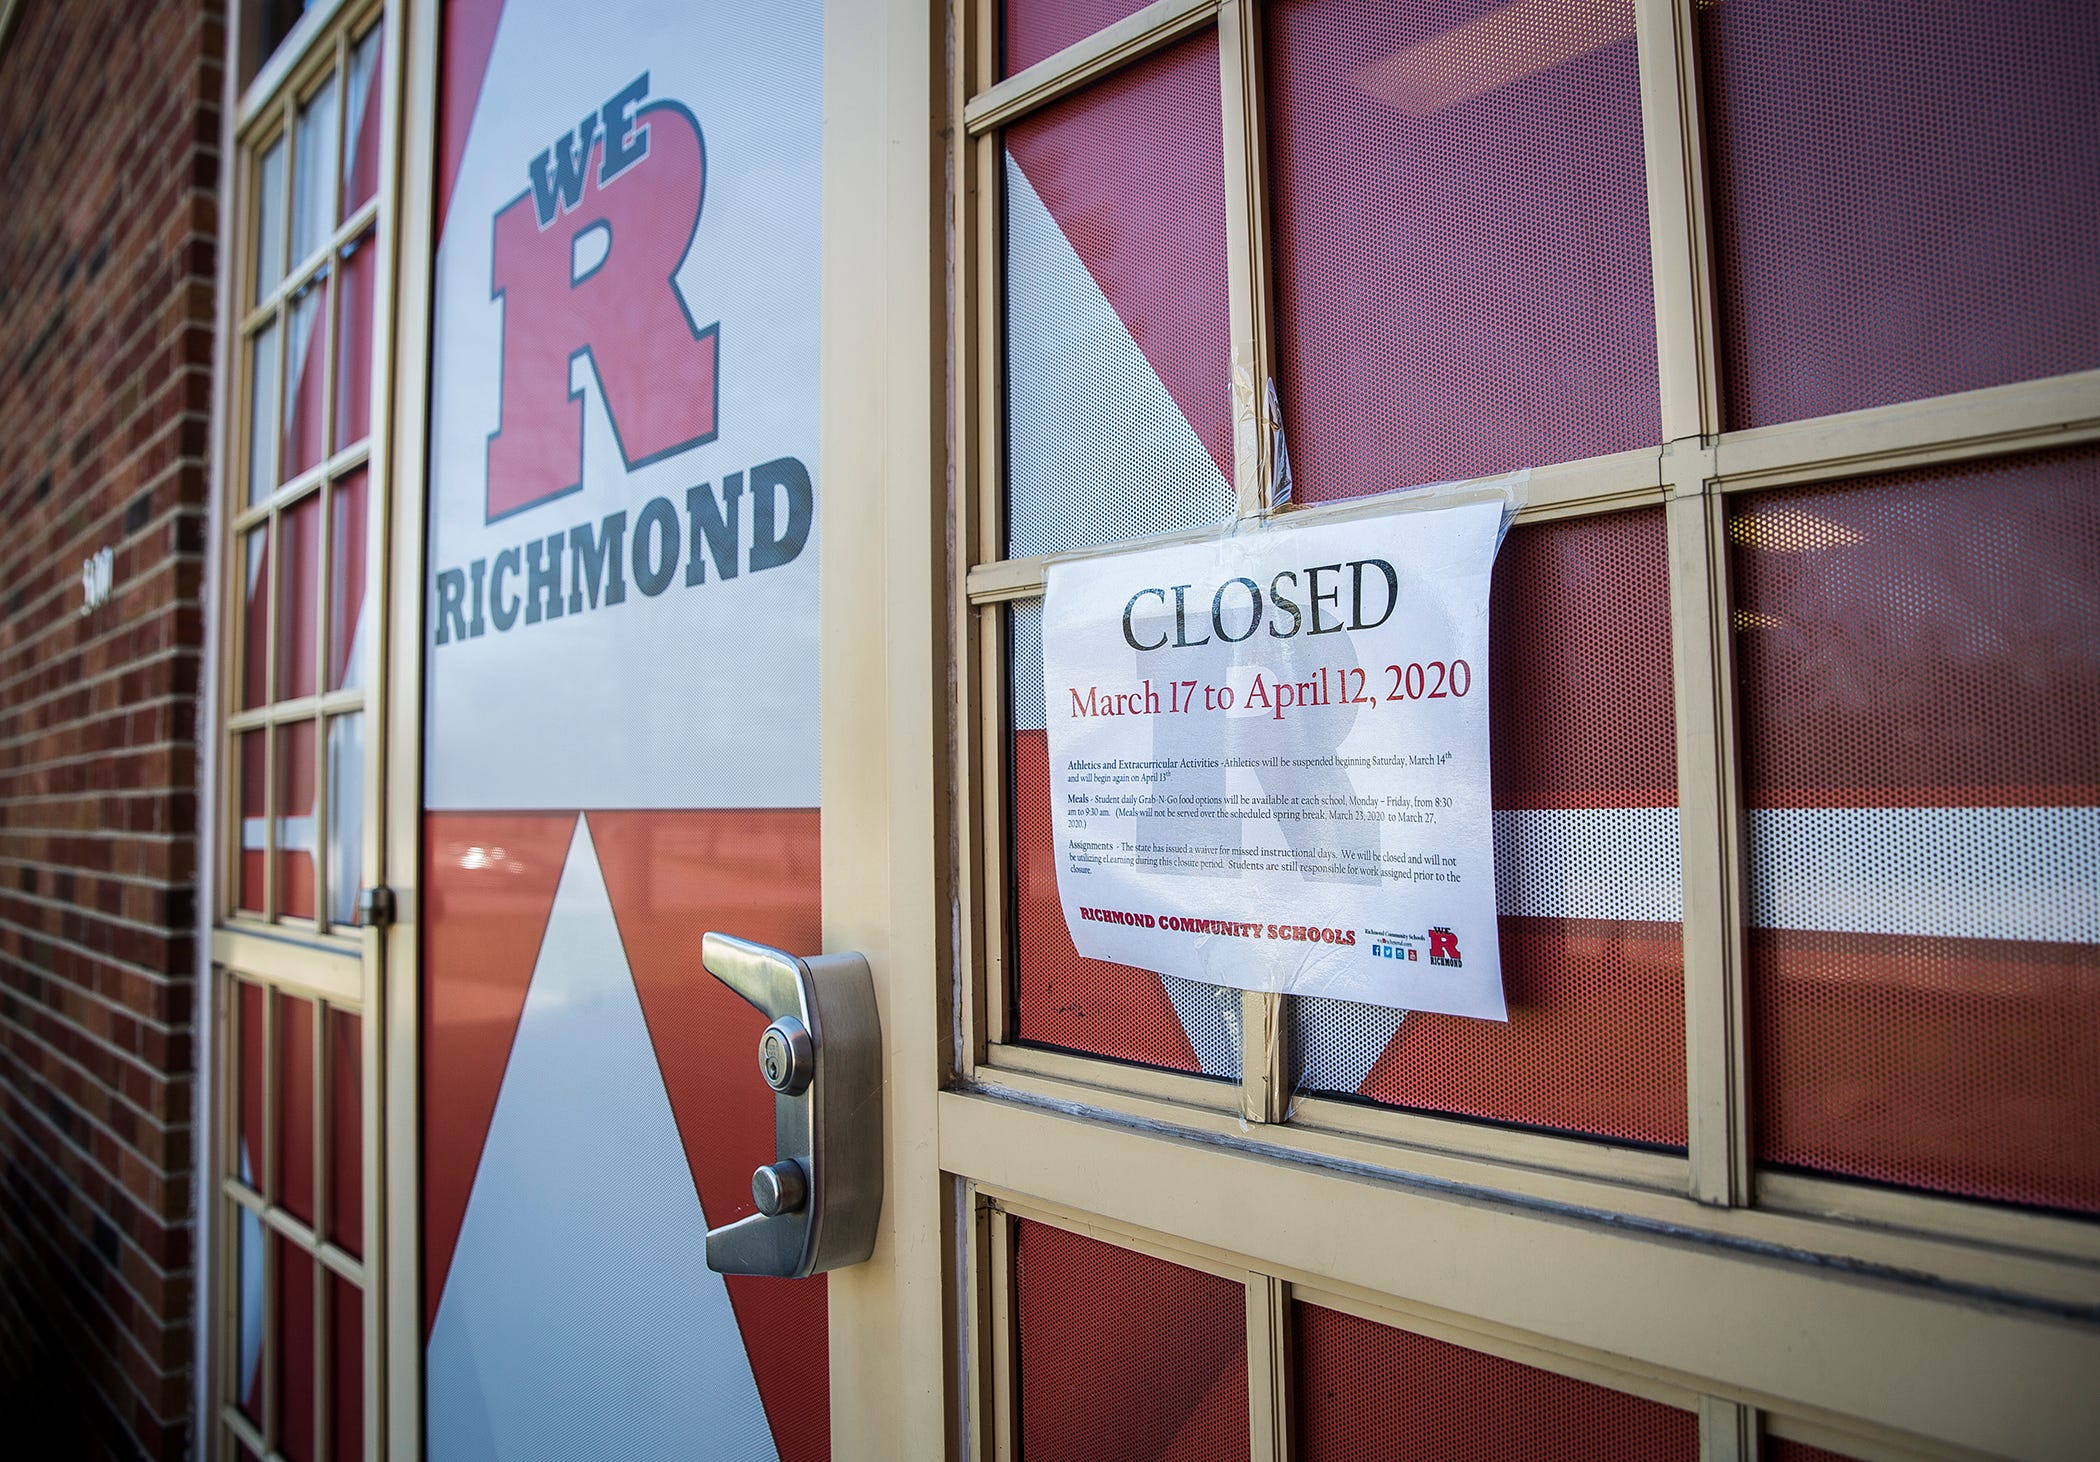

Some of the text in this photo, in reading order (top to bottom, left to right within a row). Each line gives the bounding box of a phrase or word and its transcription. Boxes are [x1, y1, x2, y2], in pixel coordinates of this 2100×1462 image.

[528, 69, 651, 232] WE
[485, 97, 721, 527] R
[434, 456, 814, 648] RICHMOND
[1122, 558, 1399, 652] CLOSED
[1069, 658, 1471, 720] March 17 to April 12, 2020
[1067, 759, 1101, 770] Athletics
[1102, 759, 1117, 770] and
[1119, 757, 1178, 770] Extracurricular
[1180, 757, 1219, 768] Activities
[1262, 756, 1278, 767] will
[1280, 756, 1291, 767] be
[1292, 755, 1334, 769] suspended
[1335, 755, 1371, 769] beginning
[1372, 754, 1408, 768] Saturday,
[1408, 753, 1435, 766] March
[1067, 773, 1079, 782] and
[1080, 773, 1093, 782] will
[1093, 773, 1111, 785] begin
[1112, 774, 1130, 785] again
[1141, 772, 1158, 784] April
[1067, 793, 1089, 804] Meals
[1094, 794, 1120, 804] Student
[1121, 794, 1138, 806] daily
[1179, 794, 1194, 805] food
[1195, 795, 1222, 807] options
[1224, 794, 1239, 804] will
[1240, 794, 1250, 805] be
[1251, 794, 1289, 805] available
[1290, 796, 1299, 805] at
[1301, 794, 1320, 805] each
[1349, 795, 1379, 808] Monday
[1386, 795, 1413, 810] Friday,
[1414, 795, 1433, 807] from
[1434, 796, 1453, 808] 8:30
[1077, 808, 1085, 816] to
[1115, 807, 1139, 819] (Meals
[1139, 808, 1153, 817] will
[1154, 809, 1165, 817] not
[1167, 808, 1176, 817] be
[1176, 808, 1199, 818] served
[1200, 810, 1215, 818] over
[1216, 808, 1229, 818] the
[1230, 808, 1271, 819] scheduled
[1272, 809, 1301, 822] spring
[1329, 809, 1354, 820] March
[1367, 811, 1386, 821] 2020
[1388, 813, 1397, 821] to
[1397, 811, 1423, 823] March
[1424, 812, 1437, 824] 27,
[1068, 840, 1114, 852] Assignments
[1120, 842, 1134, 851] The
[1134, 843, 1151, 852] state
[1152, 843, 1165, 853] has
[1165, 844, 1188, 853] issued
[1194, 845, 1218, 855] waiver
[1219, 844, 1230, 855] for
[1231, 845, 1259, 856] missed
[1261, 847, 1316, 858] instructional
[1317, 848, 1338, 861] days.
[1341, 849, 1356, 860] We
[1357, 850, 1372, 861] will
[1372, 851, 1382, 861] be
[1382, 851, 1406, 863] closed
[1407, 853, 1423, 864] and
[1423, 854, 1440, 865] will
[1442, 857, 1457, 866] not
[1068, 852, 1077, 861] be
[1077, 853, 1102, 865] utilizing
[1135, 855, 1158, 868] during
[1159, 857, 1173, 866] this
[1173, 856, 1199, 867] closure
[1200, 859, 1225, 870] period.
[1227, 859, 1264, 871] Students
[1265, 863, 1279, 871] are
[1281, 861, 1298, 872] still
[1299, 863, 1346, 875] responsible
[1347, 863, 1359, 875] for
[1359, 865, 1379, 877] work
[1380, 868, 1412, 881] assigned
[1413, 869, 1434, 883] prior
[1435, 872, 1445, 882] to
[1446, 870, 1461, 882] the
[1079, 906, 1356, 946] RICHMOND COMMUNITY SCHOOLS
[1385, 931, 1409, 941] Community
[1409, 933, 1426, 942] Schools
[1433, 926, 1451, 935] WE
[1428, 929, 1461, 960] R
[1430, 956, 1463, 968] RICHMOND
